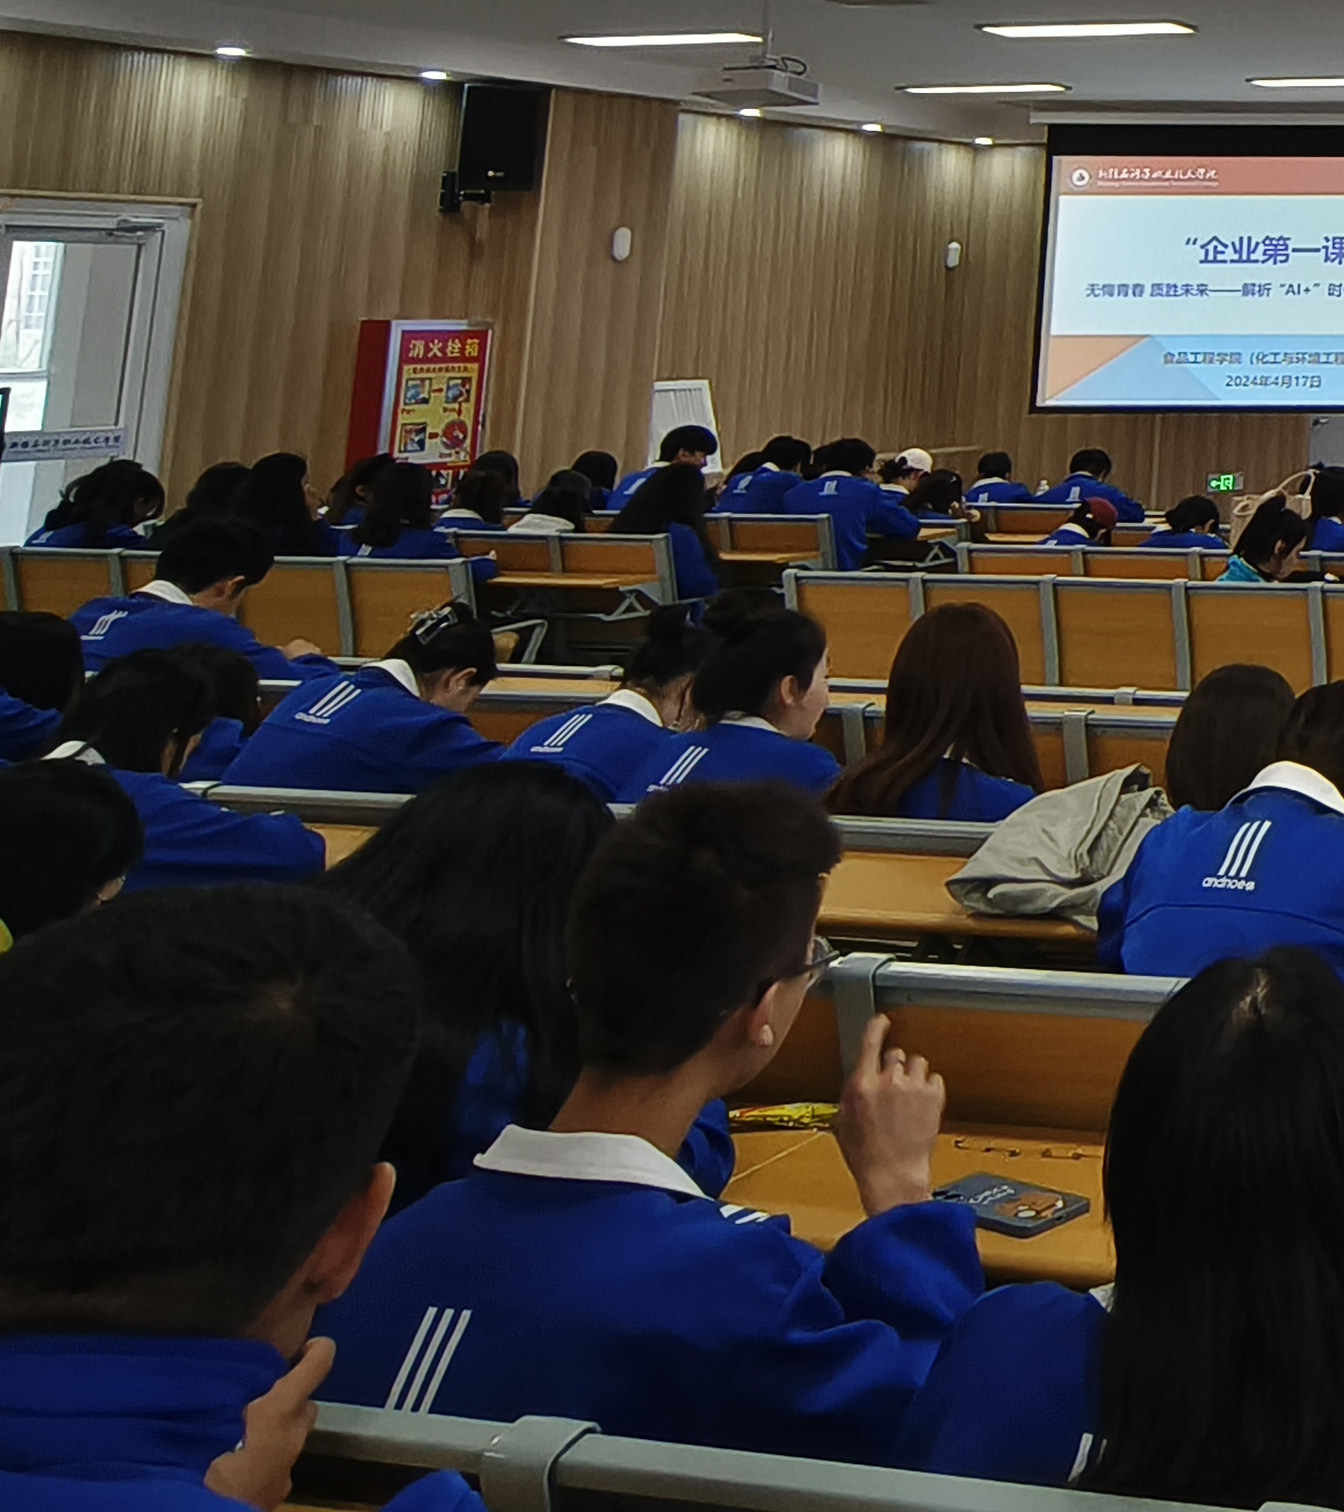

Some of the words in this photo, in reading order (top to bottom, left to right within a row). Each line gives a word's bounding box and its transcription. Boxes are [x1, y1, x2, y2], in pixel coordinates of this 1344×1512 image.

[408, 337, 480, 359] 消火栓箱
[1225, 374, 1322, 390] 2024年4月17日
